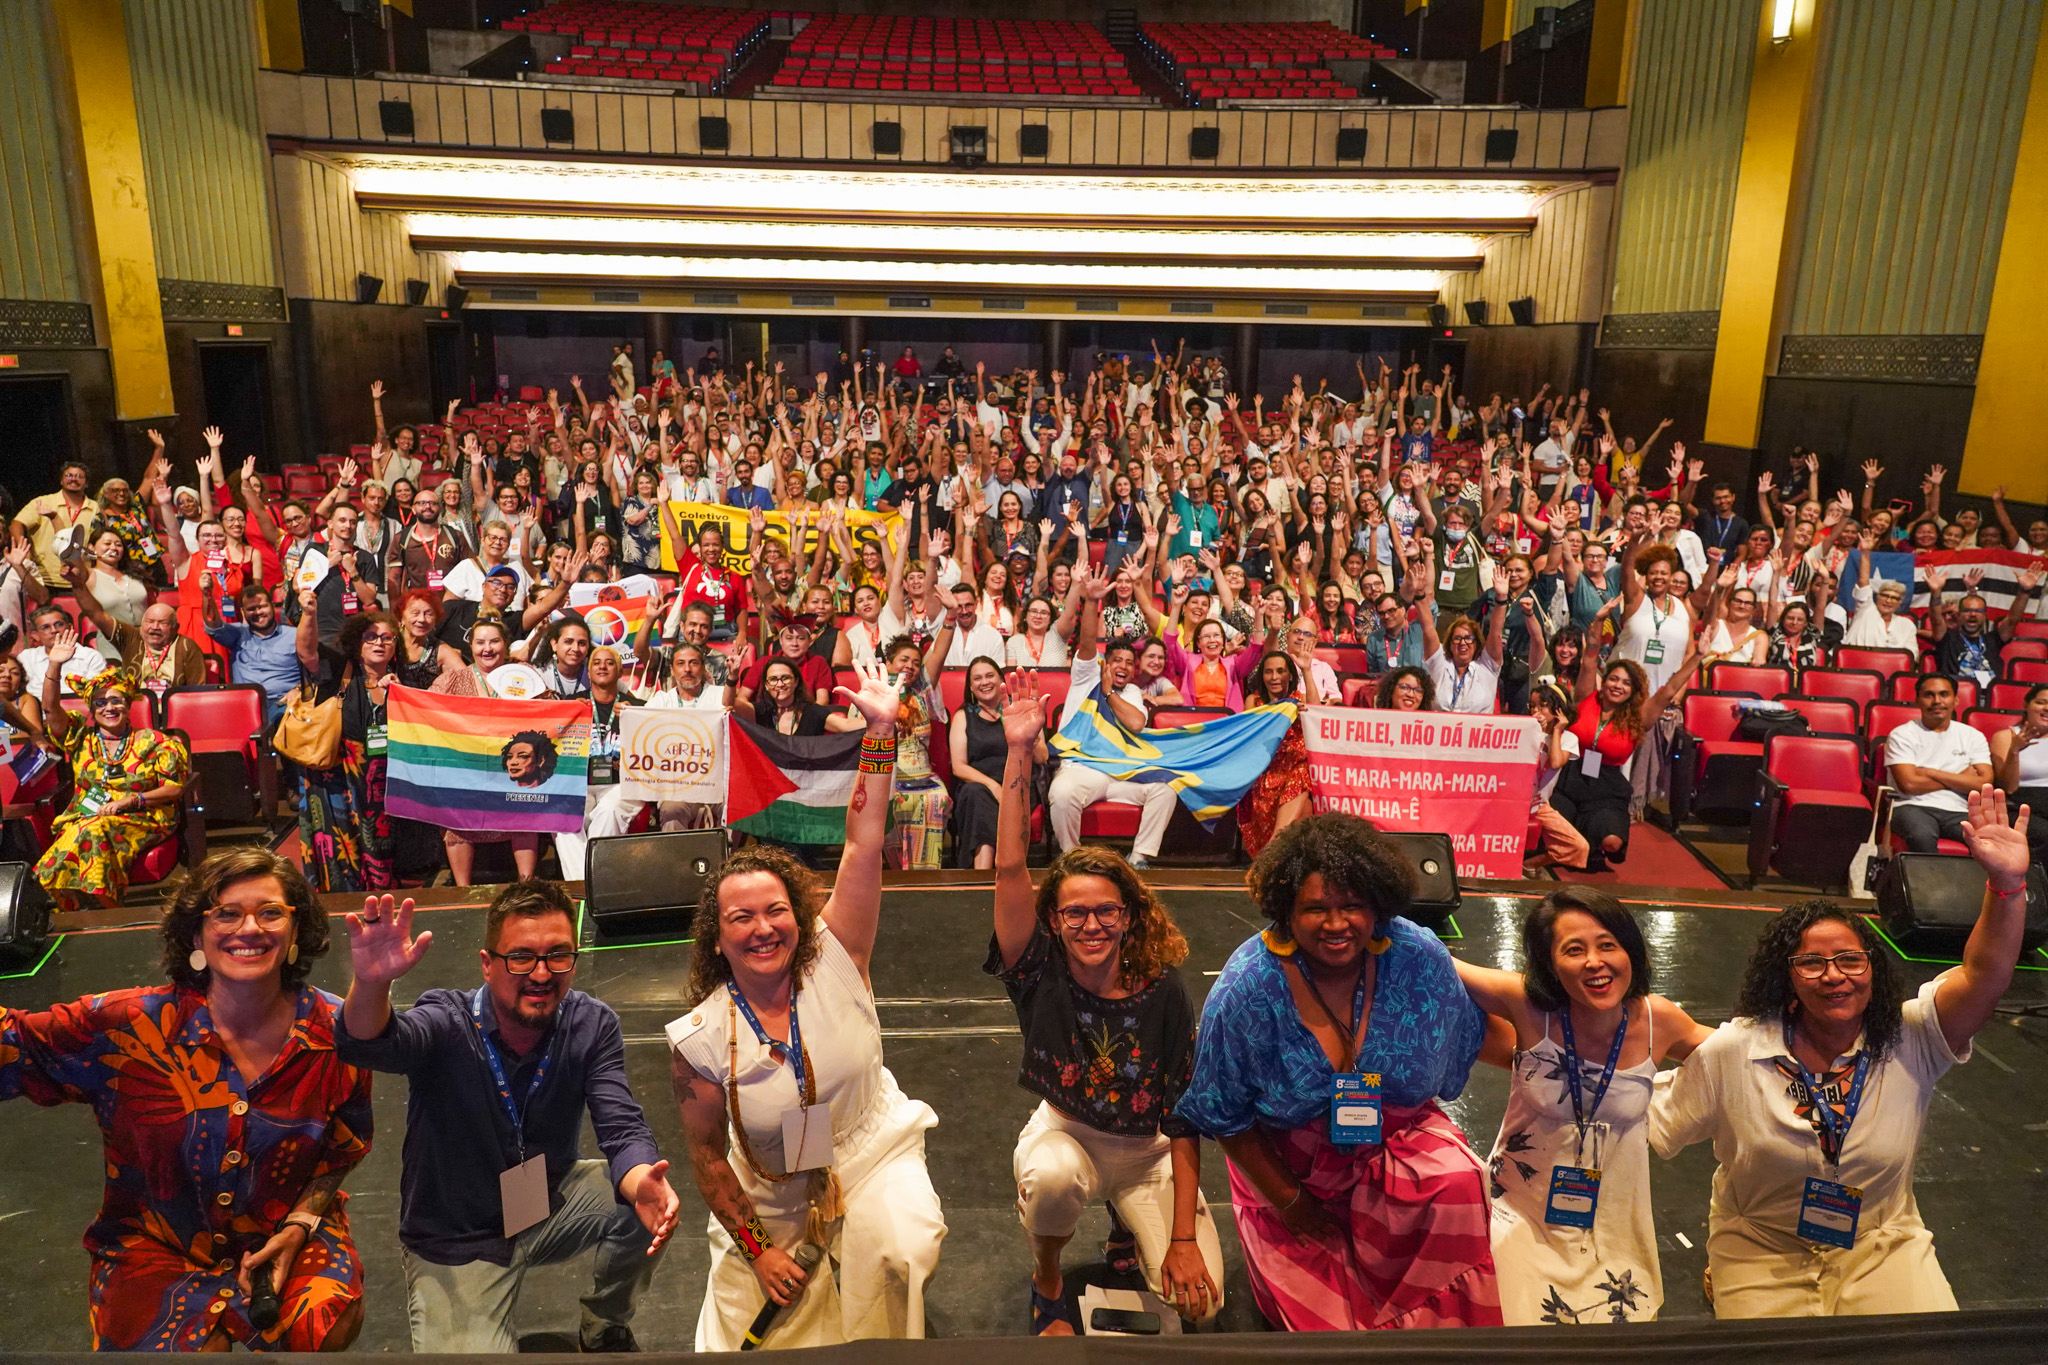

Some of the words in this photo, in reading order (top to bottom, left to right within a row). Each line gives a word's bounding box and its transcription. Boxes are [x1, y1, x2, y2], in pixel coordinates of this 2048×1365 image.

[679, 511, 729, 521] Coletivo
[1320, 718, 1340, 740] EU
[1346, 720, 1395, 747] FALEI,
[1400, 719, 1434, 746] NÃO
[1440, 722, 1463, 748] DÁ
[1468, 723, 1521, 750] NÃO!!!
[628, 754, 654, 771] 20
[660, 758, 709, 775] anos
[1309, 763, 1340, 785] QUE
[1345, 767, 1506, 793] MARA-MARA-MARA-
[505, 792, 544, 803] PRESENTE
[1482, 834, 1520, 854] TER!
